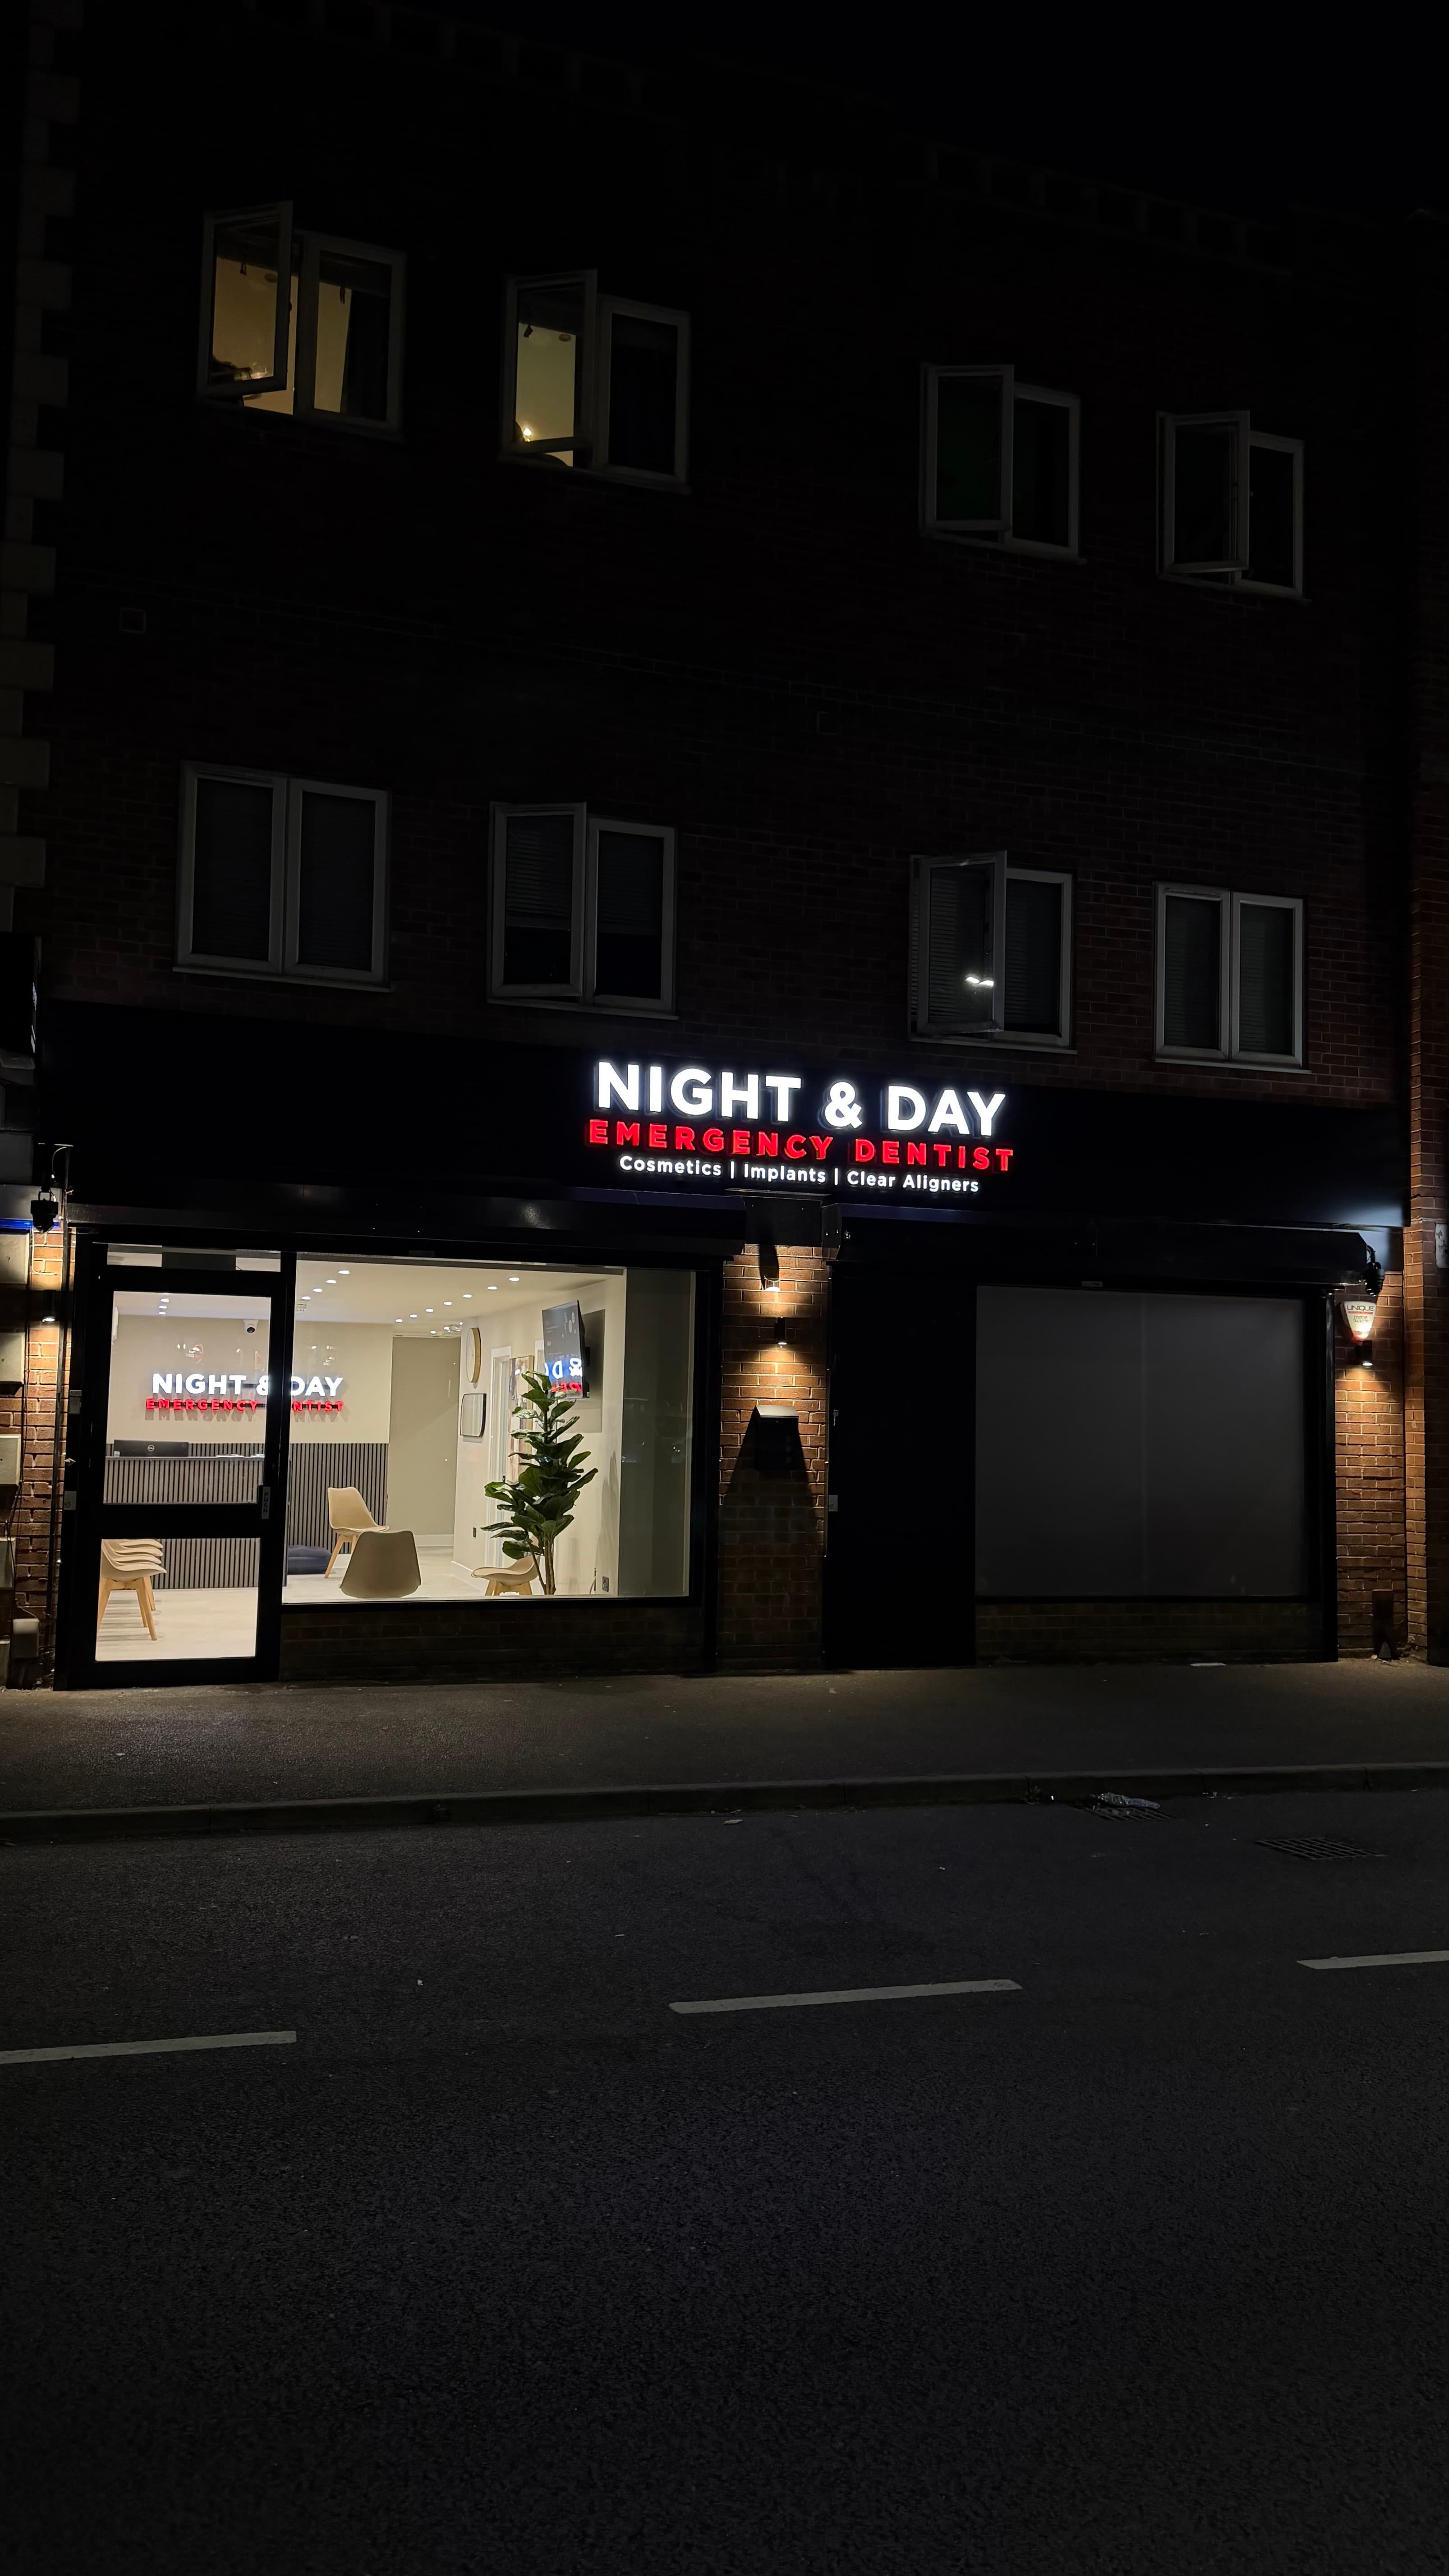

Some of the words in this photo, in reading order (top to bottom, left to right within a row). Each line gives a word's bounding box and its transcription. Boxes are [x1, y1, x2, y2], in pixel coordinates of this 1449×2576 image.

[598, 1061, 802, 1122] NIGHT
[824, 1081, 863, 1129] &
[888, 1085, 1006, 1136] DAY
[589, 1118, 833, 1160] EMERGENCY
[855, 1138, 1014, 1172] DENTIST
[619, 1155, 722, 1176] Cosmetics
[744, 1163, 826, 1183] Implants
[846, 1170, 896, 1187] Clear
[902, 1174, 979, 1192] Aligners
[152, 1373, 247, 1395] NIGHT
[290, 1376, 344, 1397] DAY
[146, 1398, 259, 1412] EMERGENCY
[291, 1399, 344, 1413] NTIST
